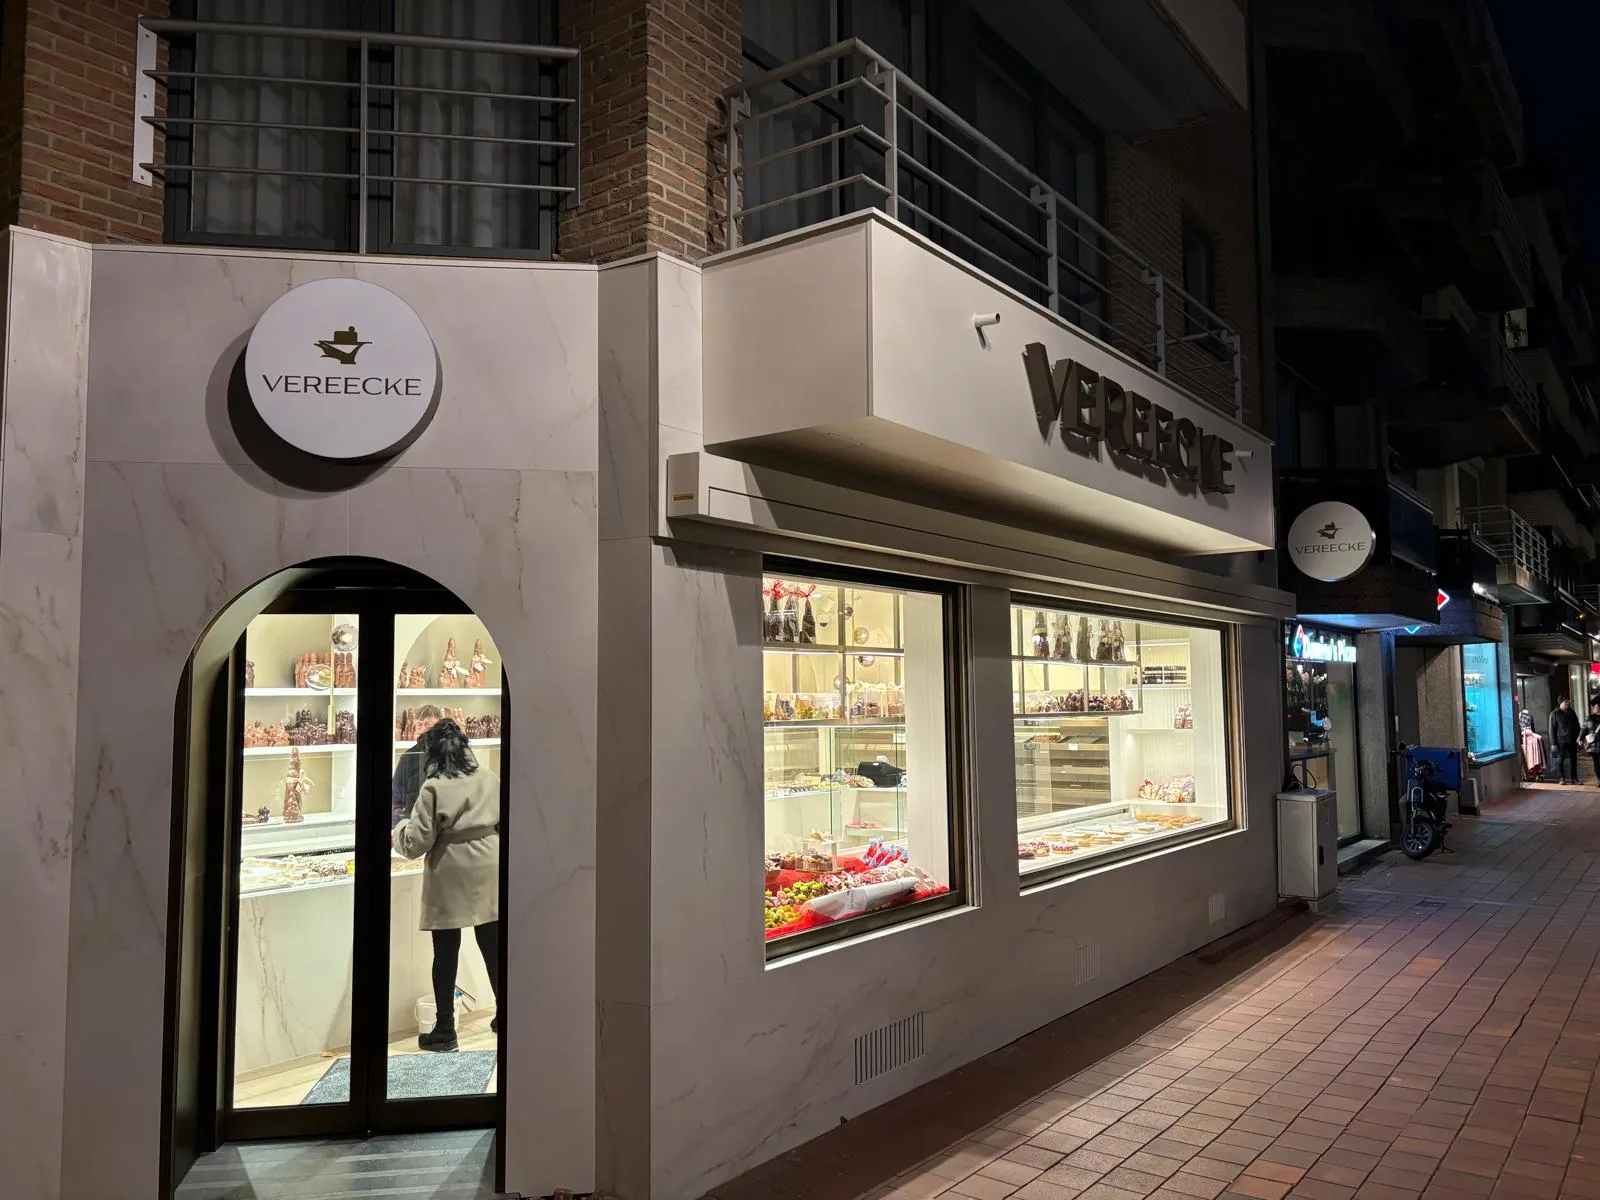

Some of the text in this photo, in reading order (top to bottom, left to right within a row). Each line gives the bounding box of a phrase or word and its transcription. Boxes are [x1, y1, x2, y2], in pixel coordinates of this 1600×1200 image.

[261, 374, 422, 396] VEREECKE
[1022, 342, 1235, 495] VEREECKE
[1295, 541, 1366, 554] VEREECKE
